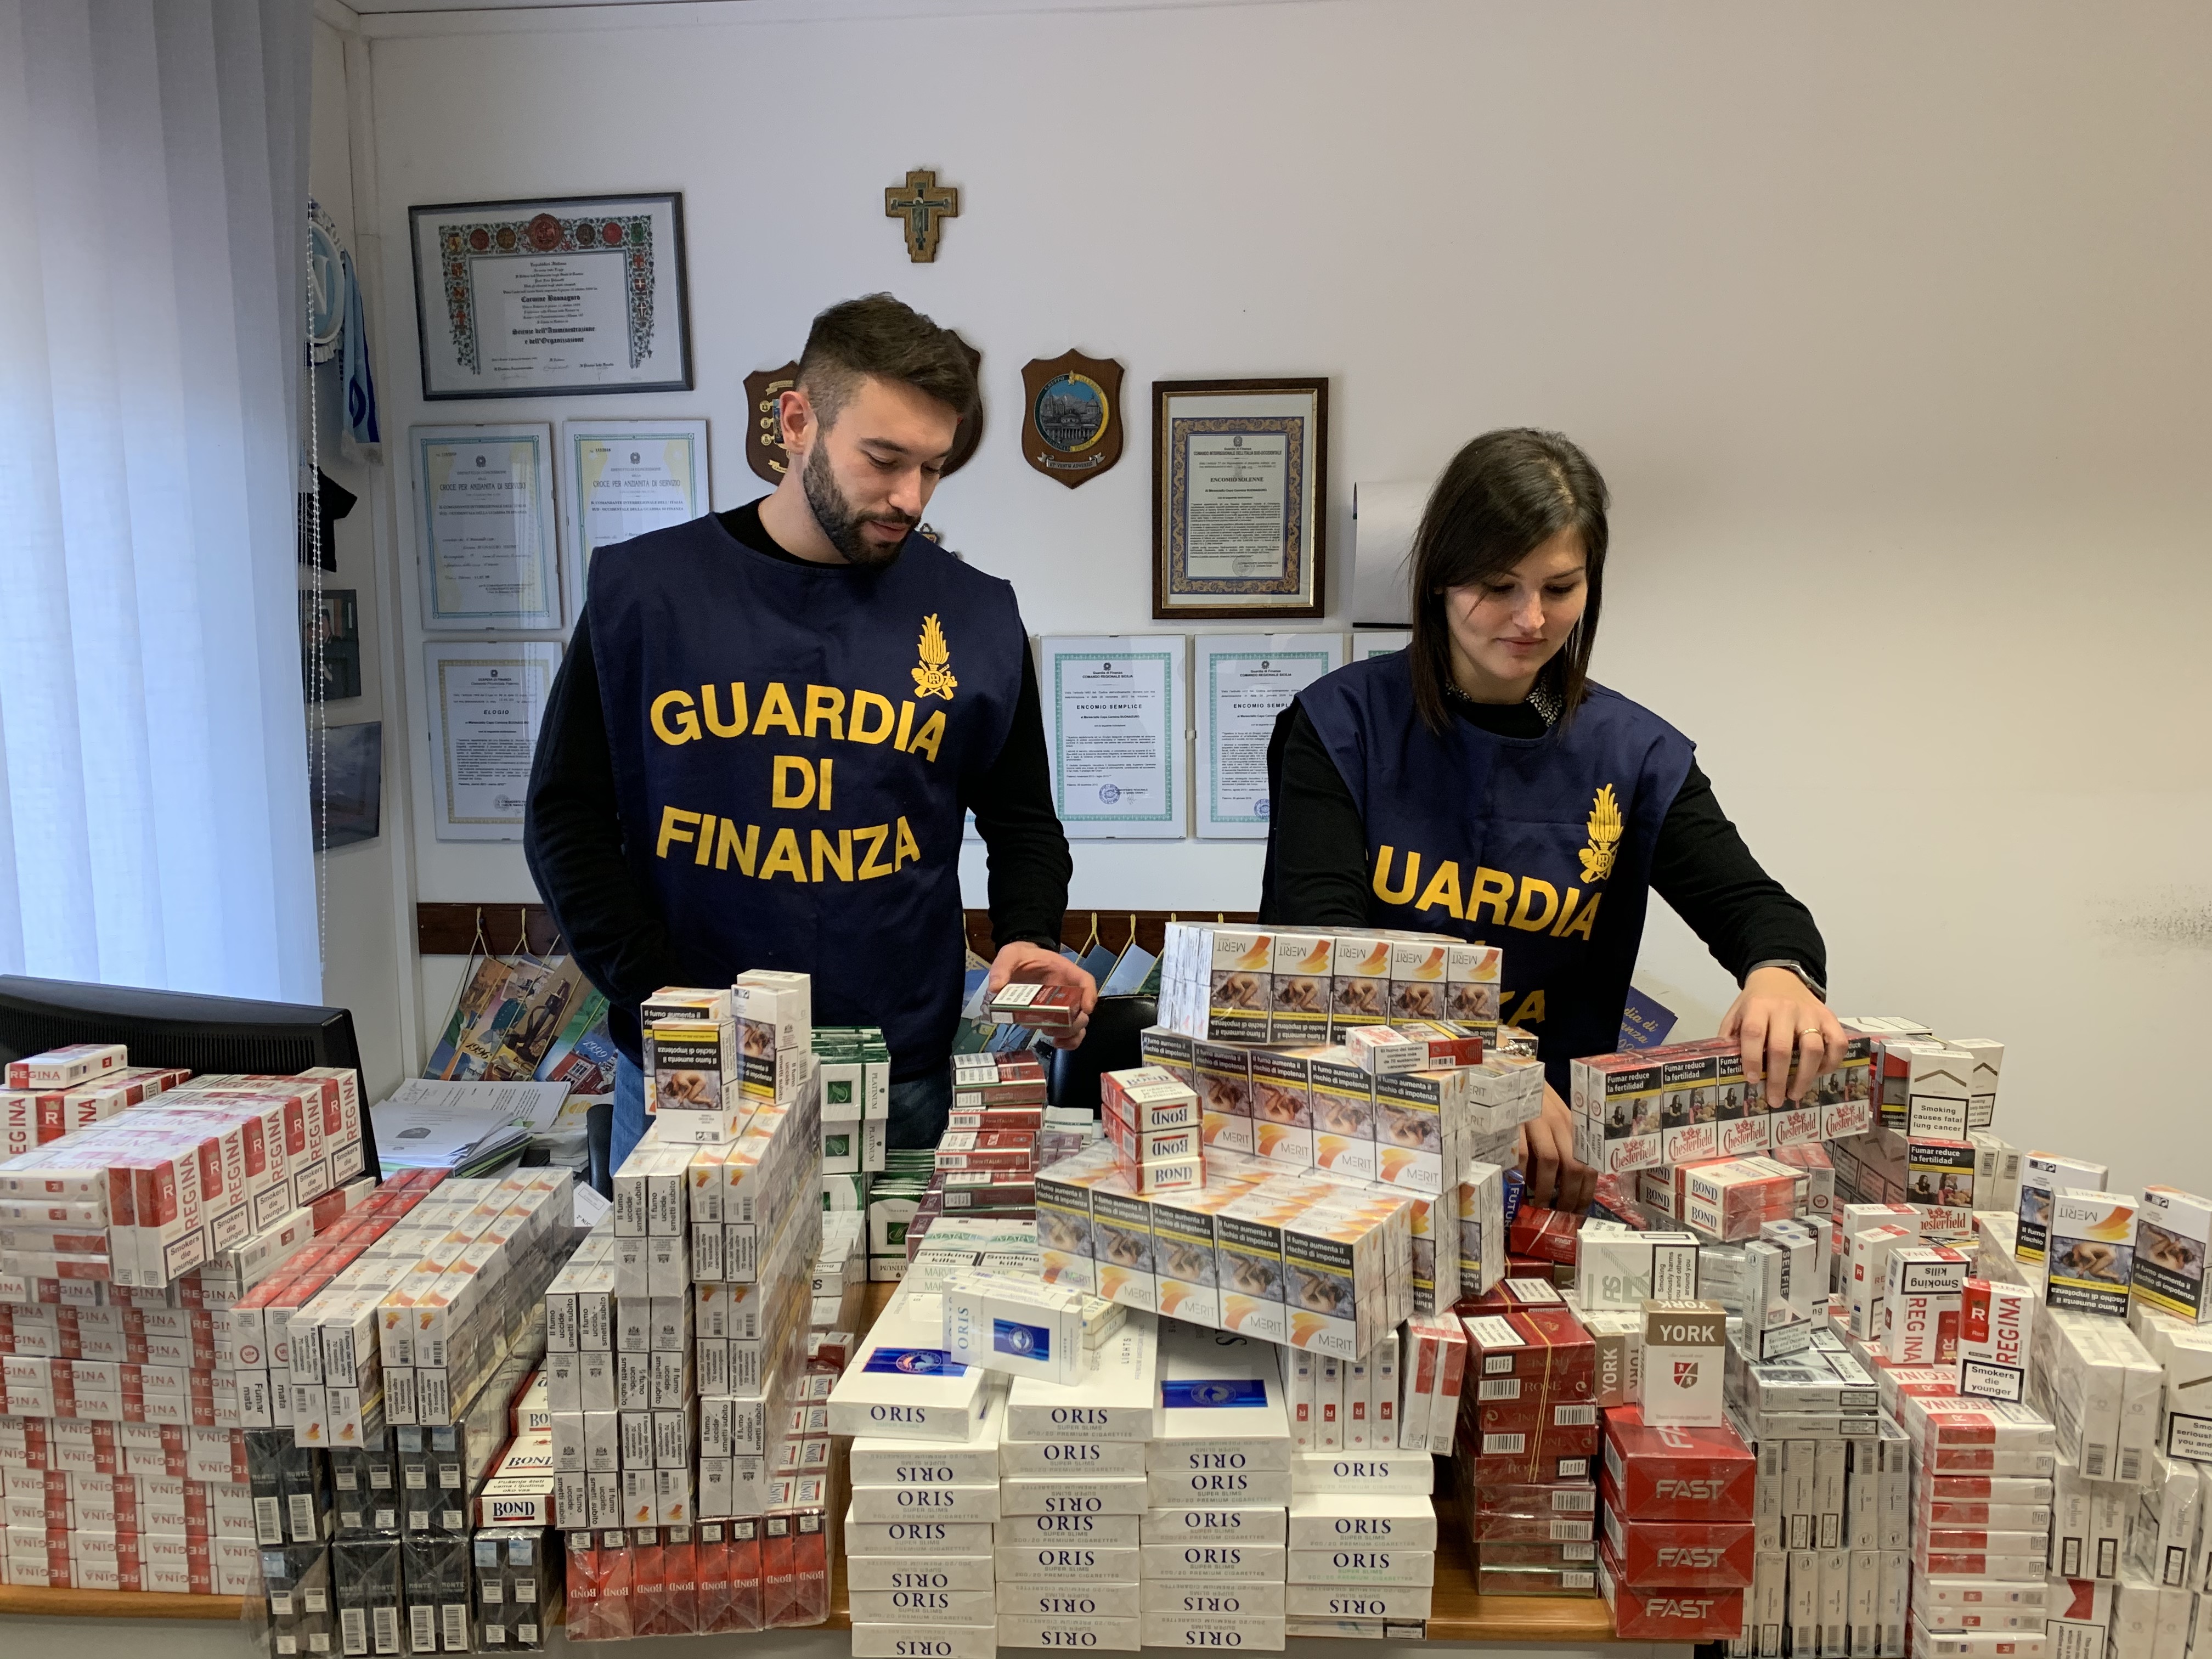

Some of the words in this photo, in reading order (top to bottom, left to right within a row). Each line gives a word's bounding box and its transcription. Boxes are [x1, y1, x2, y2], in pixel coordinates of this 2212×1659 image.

[650, 682, 946, 763] GUARDIA
[772, 755, 833, 811] DI
[656, 805, 921, 883] FINANZA
[1216, 940, 1246, 953] MERIT
[465, 1042, 492, 1059] 1996
[583, 1040, 607, 1058] 1999
[10, 1071, 60, 1080] REGINA
[1317, 1065, 1331, 1075] fumo
[1333, 1069, 1359, 1079] aumenta
[1664, 1064, 1684, 1073] Fumar
[1685, 1062, 1705, 1070] reduce
[1671, 1070, 1700, 1080] fertilidad
[1313, 1074, 1331, 1083] rischio
[1339, 1077, 1369, 1089] impotenza
[343, 1075, 357, 1142] REGINA
[1152, 1108, 1187, 1119] BOND
[1921, 1105, 1956, 1115] Smoking
[1776, 1117, 1816, 1145] Chesterfield
[1826, 1111, 1865, 1138] Chesterfield
[268, 1110, 285, 1182] REGINA
[1152, 1139, 1188, 1151] BOND
[1668, 1128, 1713, 1155] Chesterfield
[336, 1147, 358, 1161] Smokers
[1282, 1141, 1309, 1159] MERIT
[1610, 1145, 1657, 1173] Chesterfield
[1919, 1155, 1953, 1164] fertilidad
[225, 1131, 243, 1205] REGINA
[338, 1163, 358, 1177] younger
[1155, 1167, 1192, 1181] BOND
[1407, 1168, 1439, 1185] MERIT
[179, 1153, 200, 1231] REGINA
[260, 1187, 285, 1205] Smokers
[1646, 1186, 1670, 1208] BOND
[1692, 1178, 1718, 1201] BOND
[269, 1200, 278, 1209] die
[262, 1204, 286, 1222] younger
[2058, 1207, 2098, 1222] MERIT
[170, 1235, 200, 1256] Smokers
[180, 1249, 191, 1260] die
[173, 1254, 201, 1274] younger
[1925, 1267, 1947, 1276] kills
[1781, 1251, 1790, 1295] SELFIE
[40, 1284, 93, 1295] REGINA
[1910, 1278, 1959, 1289] Smoking
[182, 1289, 236, 1300] REGINA
[957, 1306, 969, 1350] ORIS
[1250, 1316, 1283, 1333] MERIT
[1903, 1297, 1927, 1363] REGINA
[1996, 1296, 2022, 1365] REGINA
[1659, 1325, 1716, 1342] YORK
[127, 1344, 180, 1356] REGINA
[1318, 1333, 1352, 1352] MERIT
[1601, 1347, 1618, 1395] YORK
[1971, 1366, 2015, 1380] Smokers
[1971, 1384, 2012, 1396] younger
[1985, 1378, 2000, 1386] die
[124, 1403, 177, 1415] REGINA
[870, 1406, 926, 1424] ORIS
[1051, 1408, 1108, 1424] ORIS
[1043, 1445, 1101, 1460] ORIS
[896, 1467, 953, 1482] ORIS
[1192, 1475, 1248, 1490] ORIS
[1656, 1480, 1725, 1499] FAST
[493, 1502, 534, 1516] BOND
[1185, 1512, 1241, 1528] ORIS
[1335, 1519, 1391, 1534] ORIS
[1185, 1548, 1241, 1564] ORIS
[1333, 1553, 1390, 1568] ORIS
[1657, 1548, 1726, 1567] FAST
[733, 1578, 759, 1588] BOND
[892, 1573, 948, 1588] ORIS
[893, 1593, 949, 1609] ORIS
[1646, 1599, 1714, 1618] FAST
